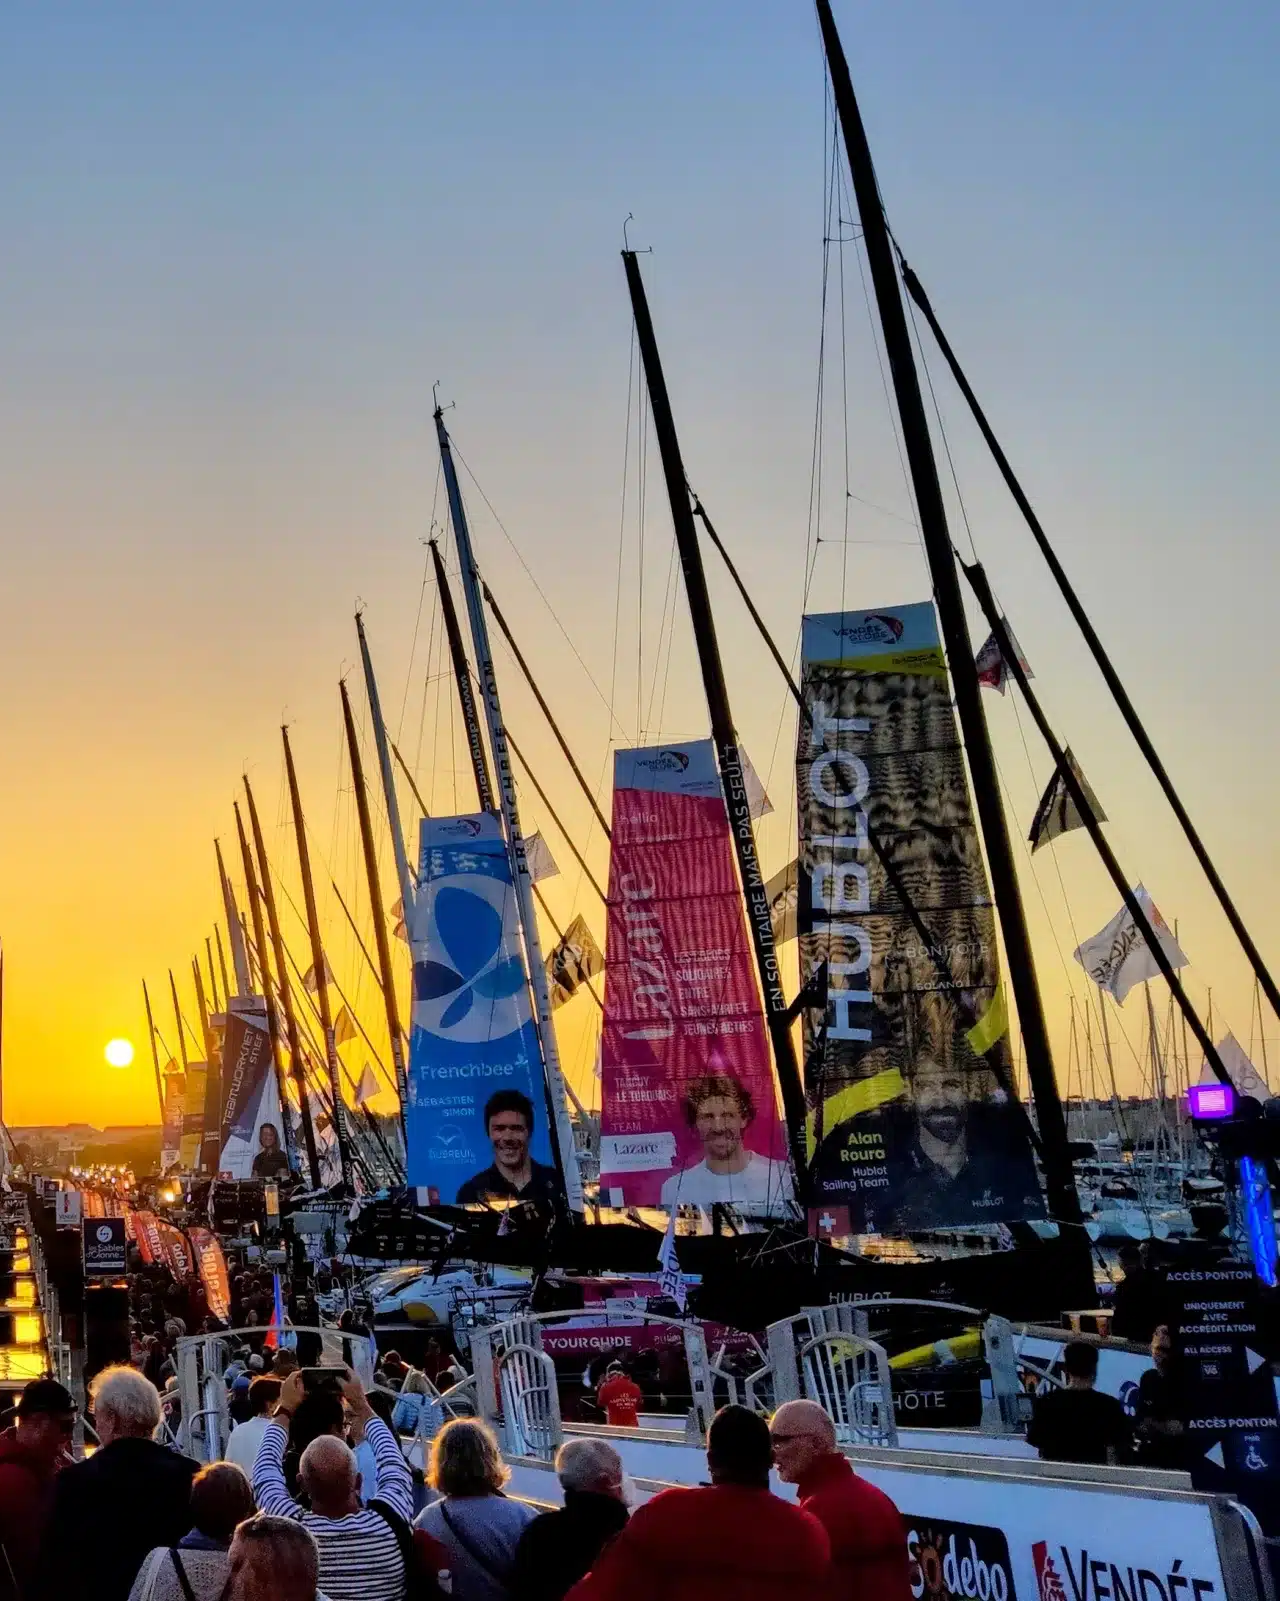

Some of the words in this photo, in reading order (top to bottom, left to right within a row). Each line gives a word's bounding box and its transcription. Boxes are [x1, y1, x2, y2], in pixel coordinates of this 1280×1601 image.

[735, 805, 753, 839] PAS
[744, 844, 763, 888] MAIS
[809, 701, 872, 1042] HUBLOT
[751, 891, 779, 982] SOLITAIRE
[619, 871, 675, 1041] Lazare
[916, 981, 963, 991] SOLANO
[683, 1021, 719, 1036] JEUNES
[419, 1060, 514, 1081] Frenchbee
[442, 1107, 476, 1117] SIMON
[610, 1122, 642, 1133] TEAM
[847, 1132, 883, 1146] Alan
[613, 1142, 660, 1155] Lazare
[840, 1149, 886, 1163] Roura
[852, 1165, 888, 1177] Hublot
[823, 1179, 857, 1192] Sailing
[859, 1176, 890, 1188] Team
[86, 1250, 120, 1259] d'Olonne
[97, 1243, 125, 1252] Sables
[1166, 1269, 1204, 1281] ACCÈS
[1205, 1270, 1253, 1281] PONTON
[828, 1290, 893, 1303] HUBLOT
[1183, 1301, 1245, 1311] UNIQUEMENT
[1202, 1313, 1229, 1322] AVEC
[548, 1336, 589, 1349] YOUR
[1183, 1346, 1199, 1355] ALL
[1199, 1345, 1233, 1354] ACCESS
[895, 1389, 948, 1411] HÔTE
[1188, 1415, 1227, 1429] ACCÈS
[1228, 1416, 1278, 1429] PONTON
[906, 1527, 1009, 1601] Sodebo
[1060, 1545, 1216, 1601] VENDÉE
